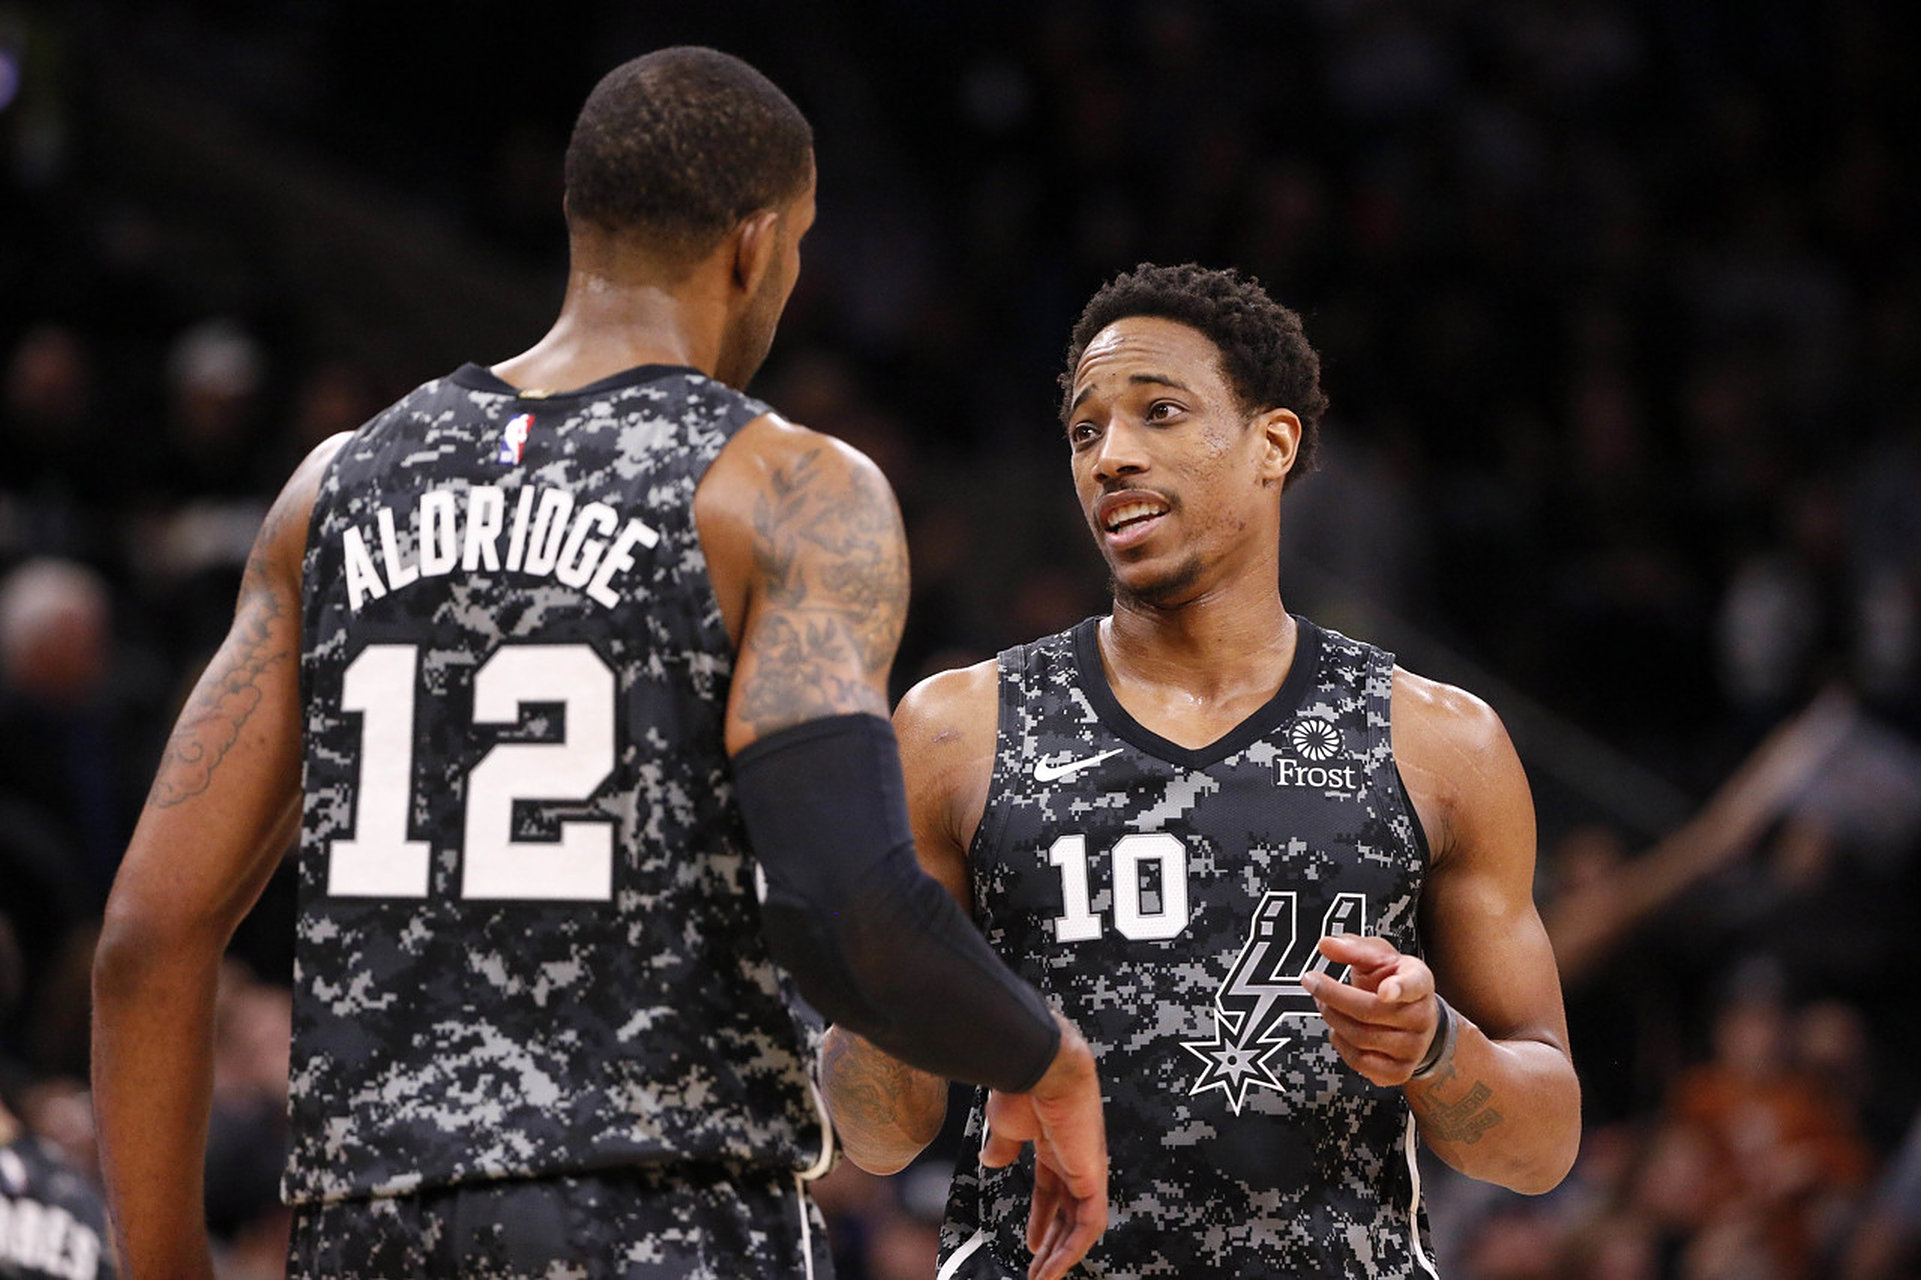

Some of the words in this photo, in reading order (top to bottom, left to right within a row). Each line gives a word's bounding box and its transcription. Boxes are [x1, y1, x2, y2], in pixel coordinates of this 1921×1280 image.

[342, 485, 659, 611] ALDRIDGE
[326, 643, 616, 900] 12
[1276, 758, 1356, 789] Frost
[1048, 832, 1189, 943] 10
